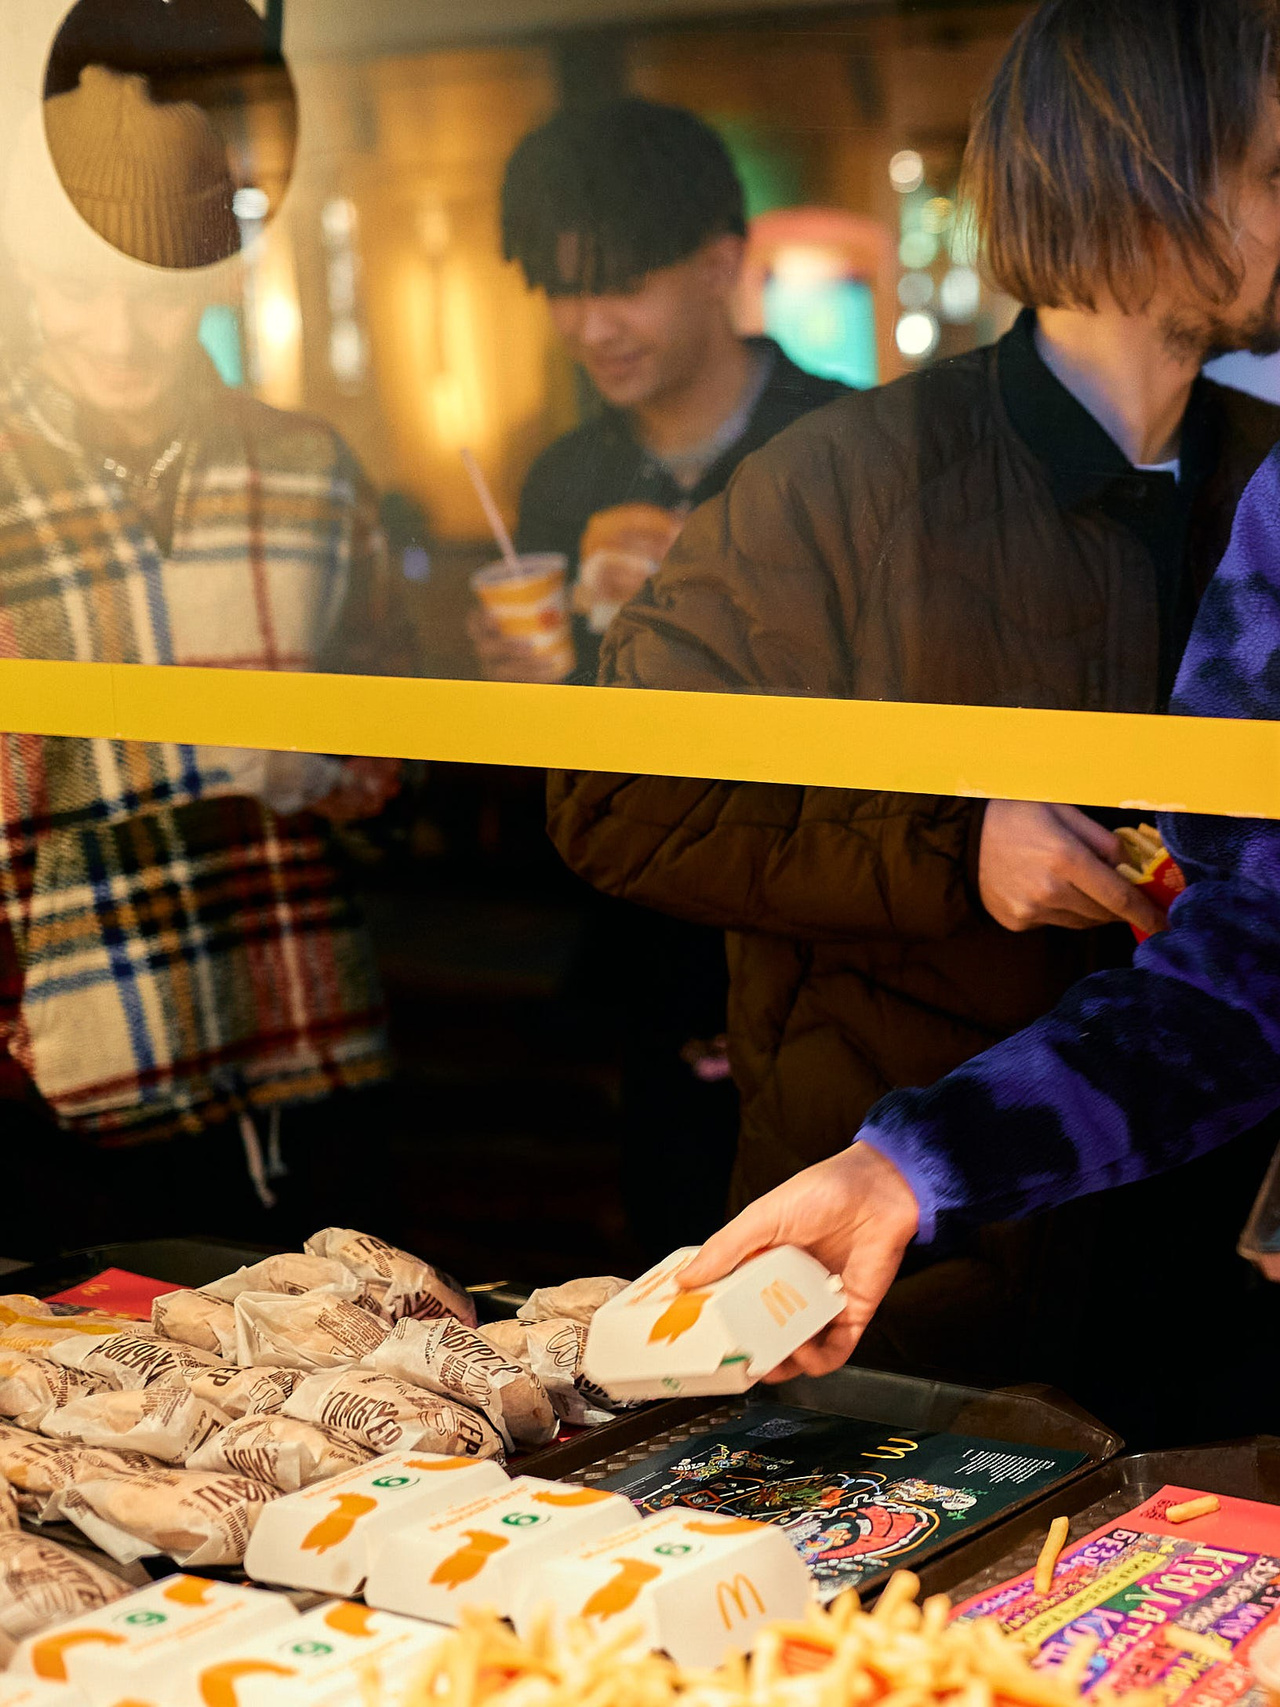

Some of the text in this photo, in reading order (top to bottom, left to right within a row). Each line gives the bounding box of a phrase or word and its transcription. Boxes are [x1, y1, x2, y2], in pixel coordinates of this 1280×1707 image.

[371, 1475, 410, 1488] 6
[501, 1512, 539, 1527] 6
[653, 1542, 692, 1556] 6
